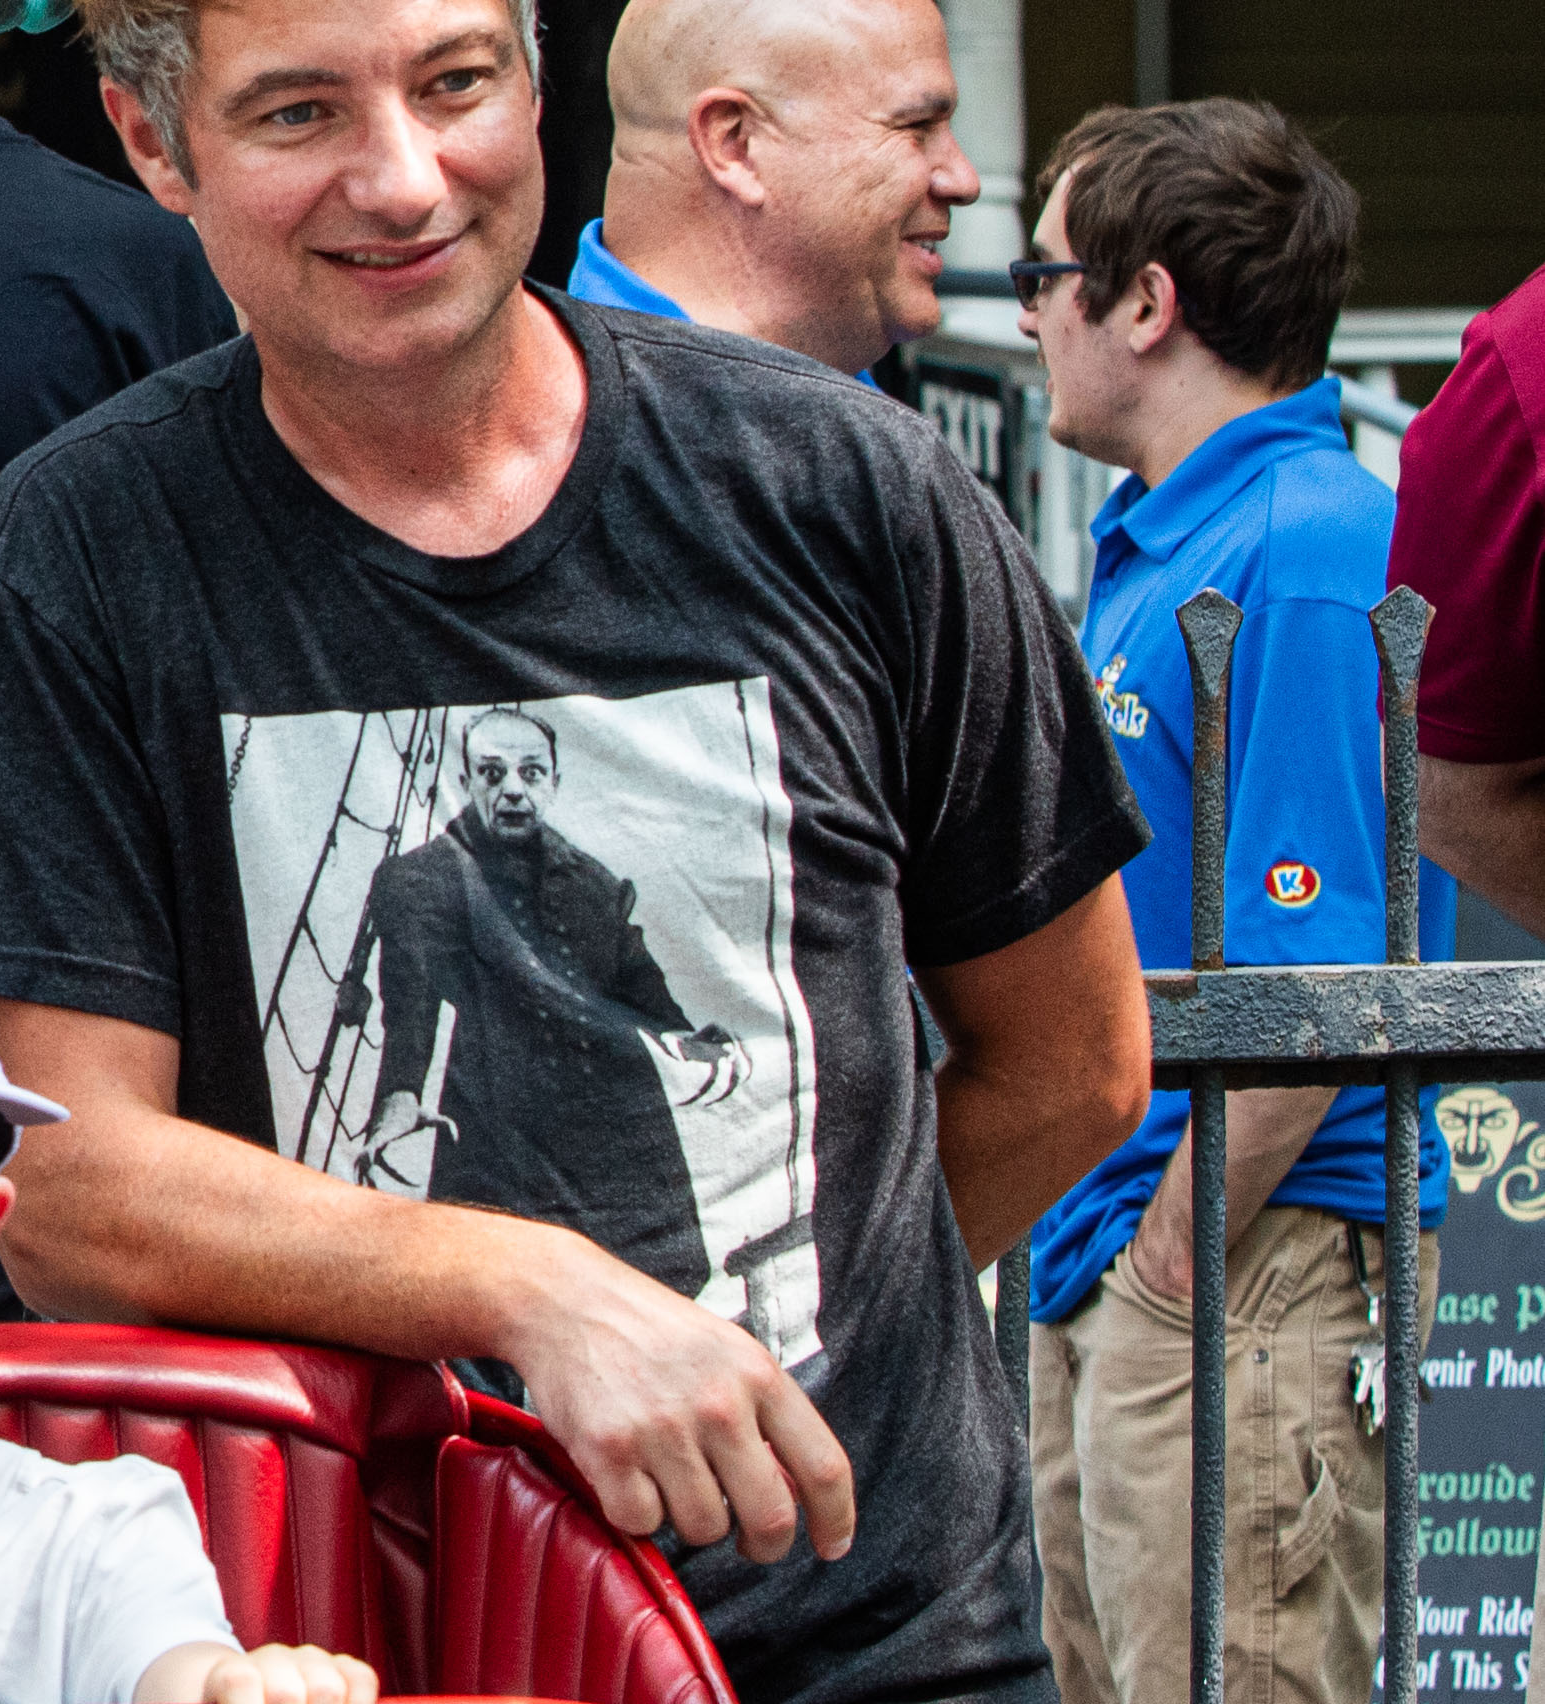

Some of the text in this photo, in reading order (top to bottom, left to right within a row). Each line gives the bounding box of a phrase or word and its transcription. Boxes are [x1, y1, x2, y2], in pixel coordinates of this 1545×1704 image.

[1438, 1292, 1499, 1325] ase
[1418, 1346, 1545, 1388] venir Phot
[1418, 1461, 1536, 1502] rovide
[1418, 1515, 1539, 1558] Follow
[1417, 1595, 1470, 1636] Your
[1450, 1649, 1503, 1691] This
